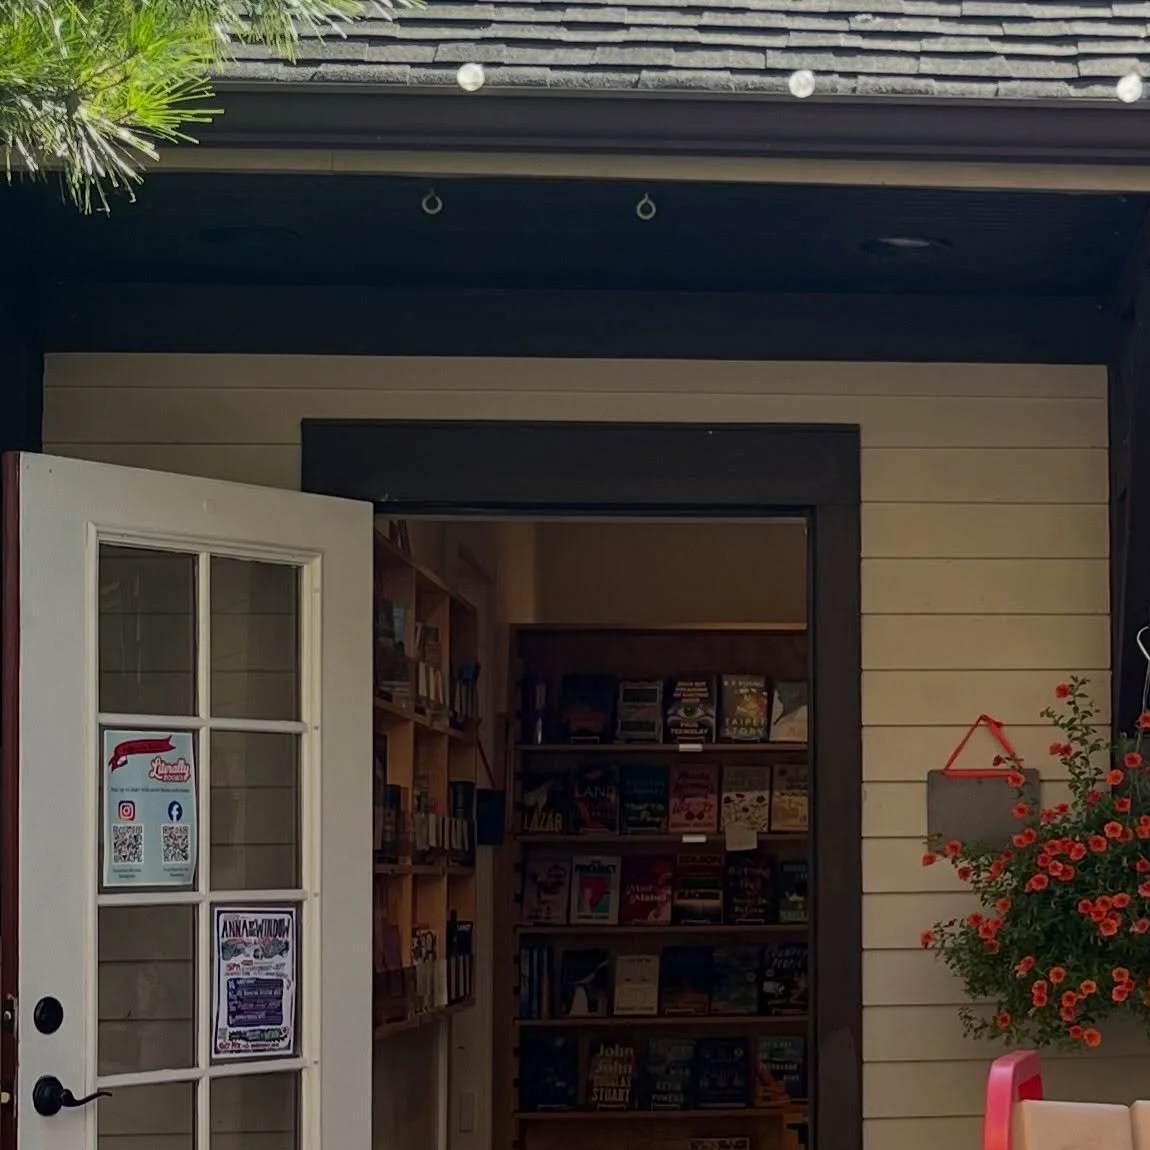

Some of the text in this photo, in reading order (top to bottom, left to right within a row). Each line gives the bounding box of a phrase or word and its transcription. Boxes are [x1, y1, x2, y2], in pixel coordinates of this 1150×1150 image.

[222, 919, 249, 938] ANNA
[597, 1043, 634, 1058] John
[591, 1088, 631, 1102] STUART
